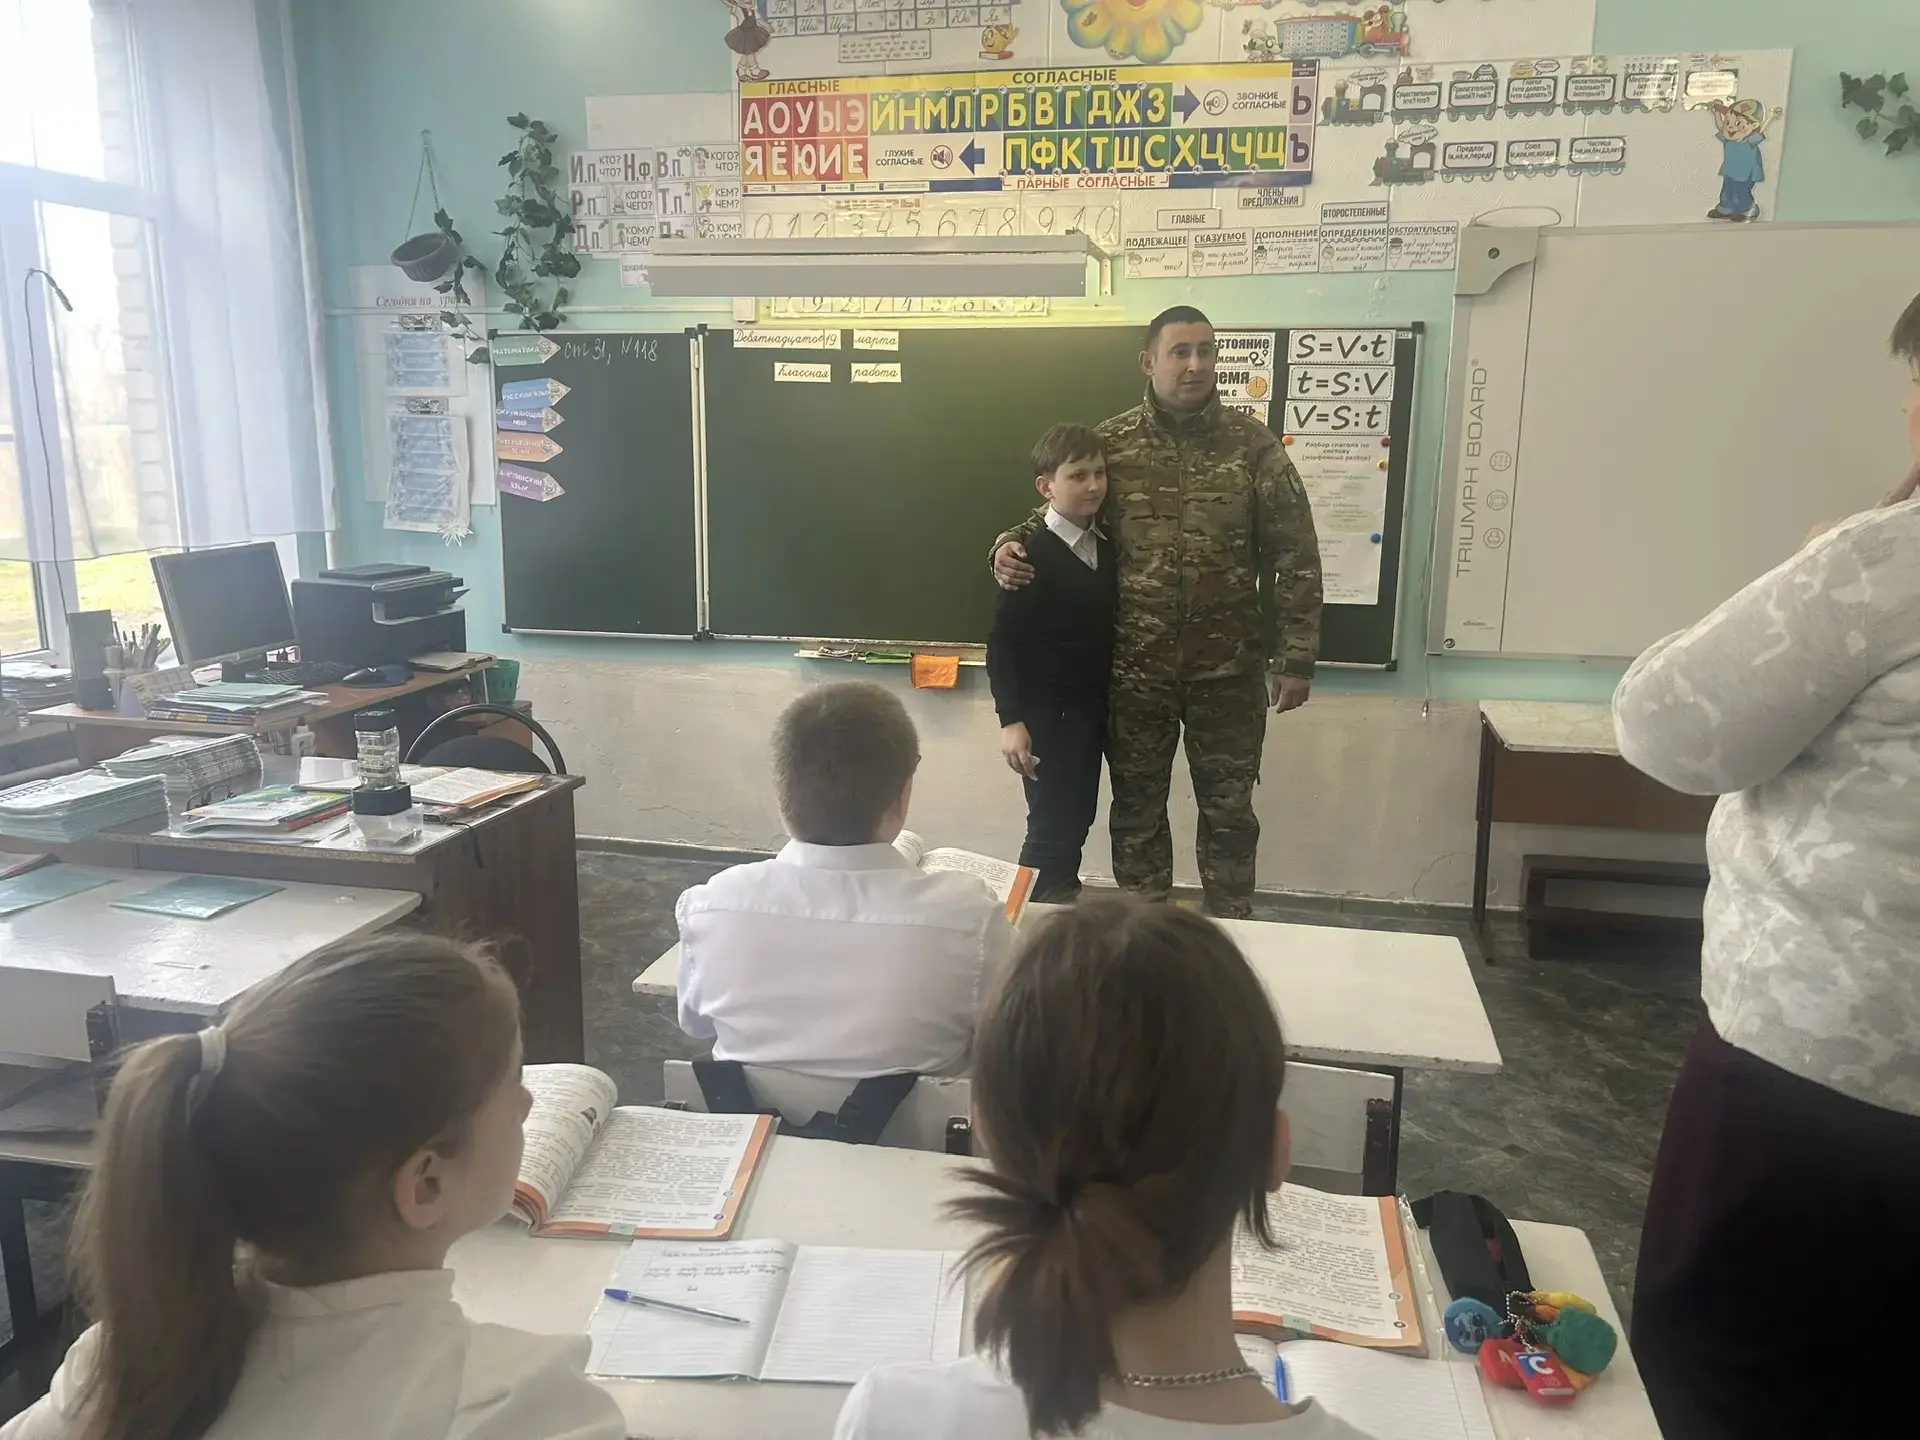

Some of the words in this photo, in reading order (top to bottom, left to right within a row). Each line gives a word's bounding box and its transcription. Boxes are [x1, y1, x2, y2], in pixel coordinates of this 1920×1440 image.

[1012, 69, 1117, 85] СОГЛАСНЫЕ
[768, 80, 840, 95] ГЛАСНЫЕ
[1236, 91, 1279, 100] ЗВОНКИЕ
[1232, 100, 1287, 110] СОГЛАСНЫЕ
[710, 151, 740, 161] КОГО?
[884, 149, 915, 158] ГЛУХИЕ
[599, 155, 622, 165] КТО?
[656, 151, 685, 178] В.п.
[875, 157, 925, 167] СОГЛАСНЫЕ
[715, 162, 740, 171] ЧТО?
[599, 167, 622, 177] ЧТО?
[1017, 177, 1070, 189] ПАРНЫЕ
[1076, 175, 1156, 188] СОГЛАСНЫЕ
[625, 190, 652, 200] КОГО?
[715, 187, 740, 197] КЕМ?
[1257, 187, 1284, 198] ЧЛЕНЫ
[625, 201, 653, 211] ЧЕГО?
[657, 187, 687, 215] Т.п.
[715, 199, 740, 209] ЧЕМ?
[1242, 196, 1299, 207] ПРЕДЛОЖЕНИЯ
[1323, 206, 1387, 218] ВТОРОСТЕПЕННЫЕ
[1171, 213, 1206, 224] ГЛАВНЫЕ
[625, 225, 655, 235] КОМУ?
[707, 223, 715, 232] О
[716, 223, 742, 232] КОМ?
[1321, 227, 1387, 238] ОПРЕДЕЛЕНИЕ
[1389, 225, 1457, 234] ОБСТОЯТЕЛЬСТВО
[1194, 231, 1247, 243] СКАЗУЕМОЕ
[1255, 229, 1318, 242] ДОПОЛНЕНИЕ
[1125, 236, 1187, 248] ПОДЛЕЖАЩЕЕ
[734, 329, 824, 348] Девятнадцатое
[825, 332, 837, 346] 19
[854, 334, 898, 349] марта
[492, 346, 540, 355] МАТЕМАТИКА
[777, 363, 829, 379] Классная
[853, 362, 899, 380] работа
[1456, 466, 1480, 578] TRIUMPH
